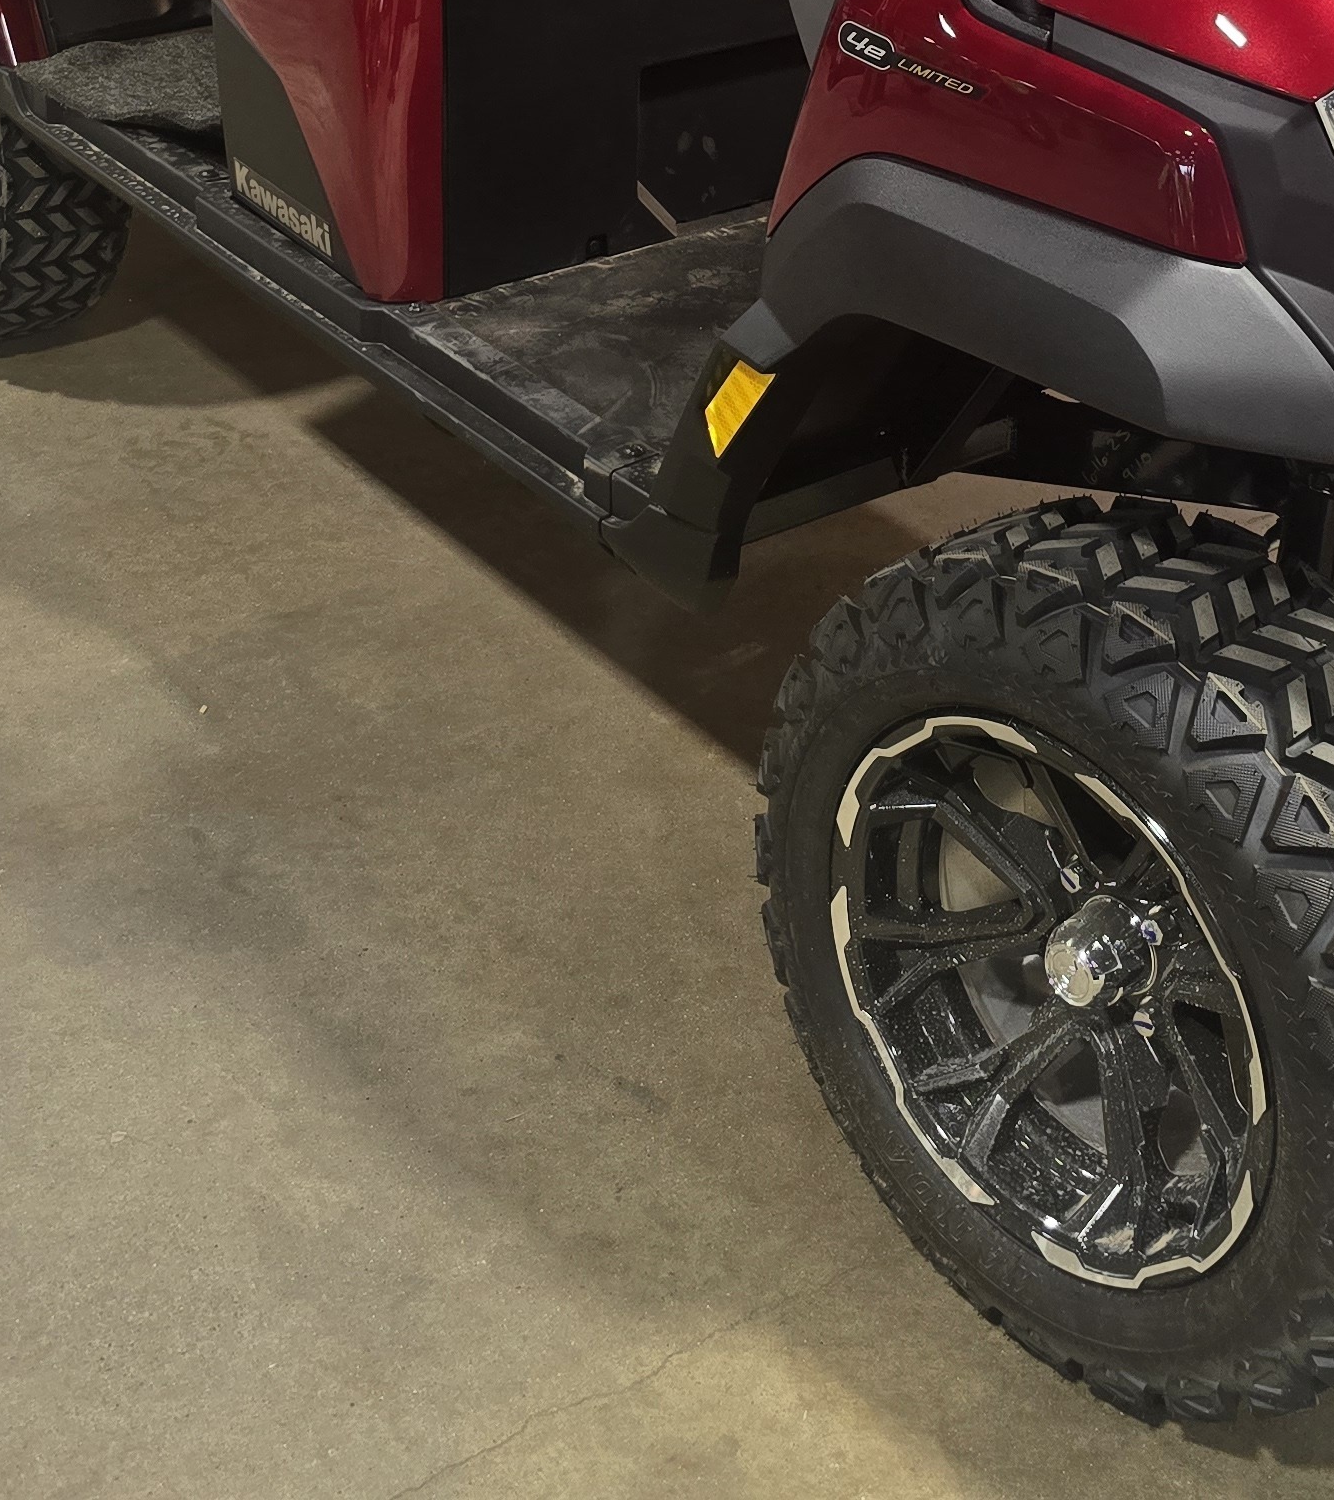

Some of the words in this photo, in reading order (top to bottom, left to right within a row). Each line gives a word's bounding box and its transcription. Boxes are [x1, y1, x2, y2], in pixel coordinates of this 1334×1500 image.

[846, 30, 887, 61] 4e
[897, 57, 975, 96] LIMITED
[234, 159, 333, 258] Kawasaki
